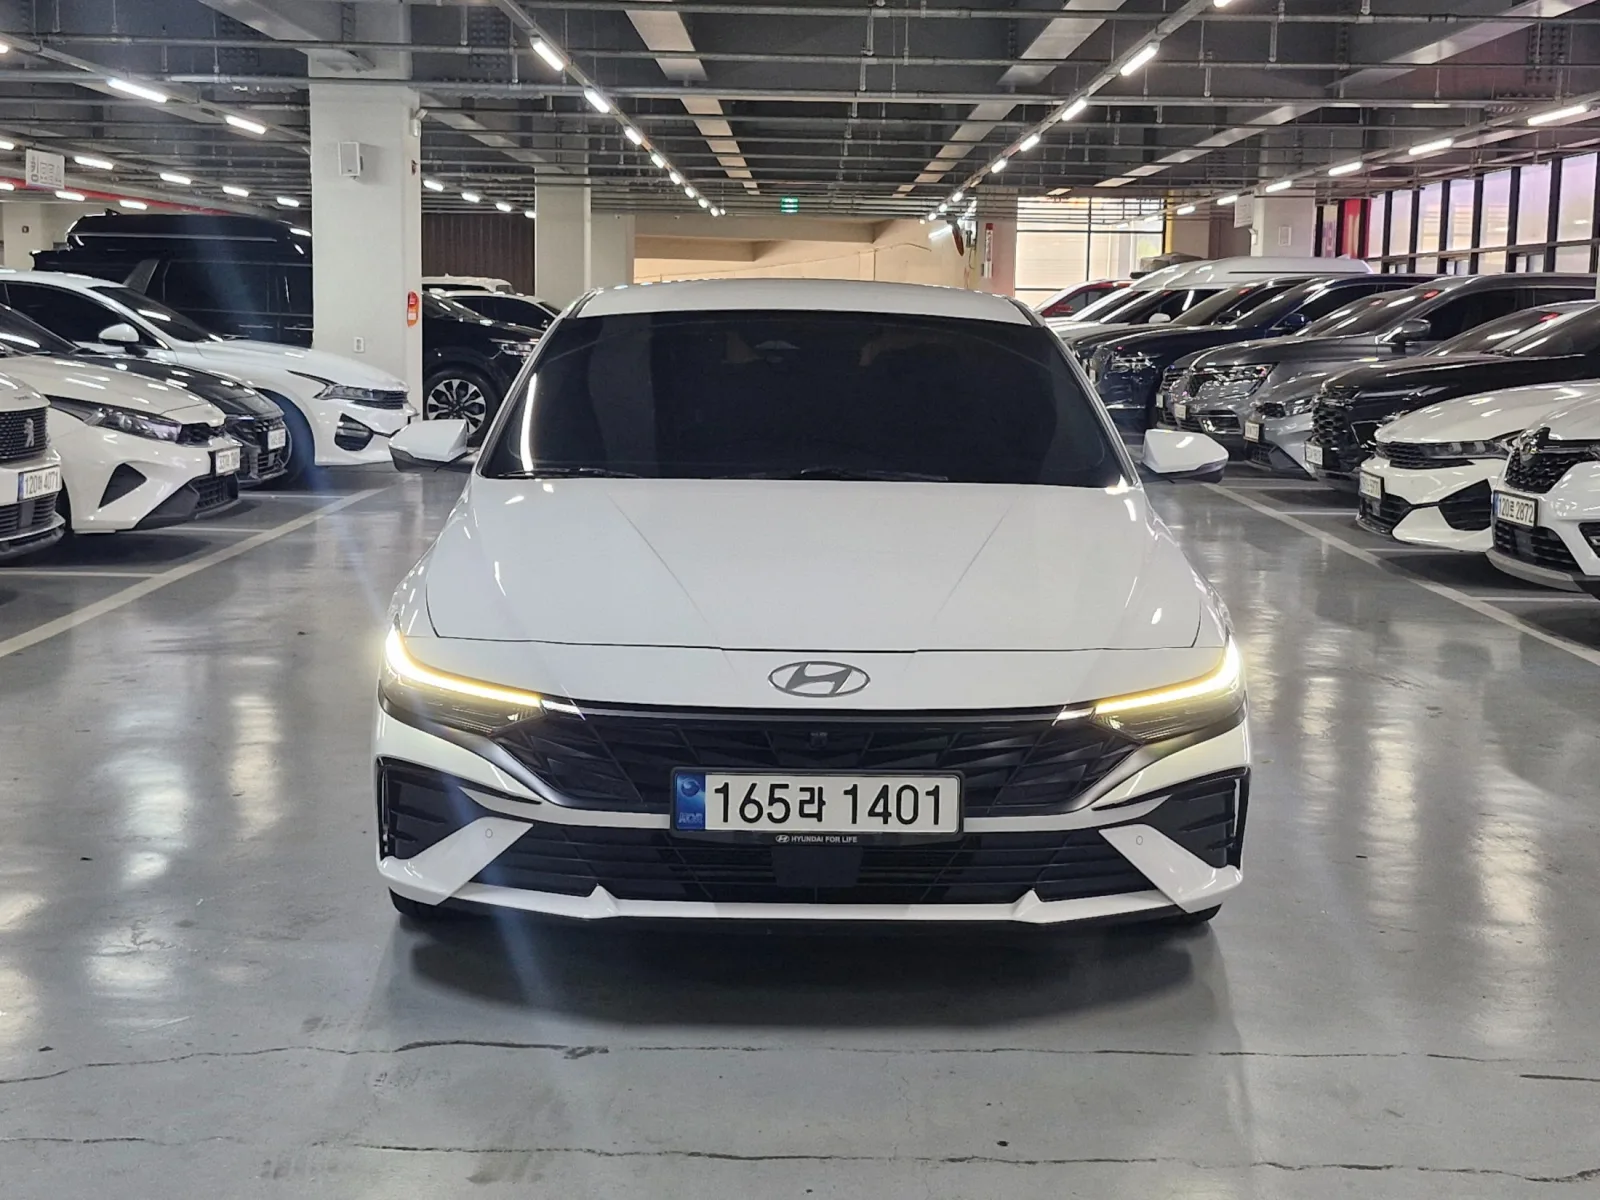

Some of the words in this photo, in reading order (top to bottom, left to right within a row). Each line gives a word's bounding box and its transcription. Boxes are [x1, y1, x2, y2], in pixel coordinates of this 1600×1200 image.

[1516, 500, 1534, 524] 2872
[714, 782, 826, 824] 165라
[843, 784, 940, 826] 1401
[791, 835, 824, 844] HYUNDAI
[825, 835, 841, 844] FOR
[841, 836, 858, 844] LIFE
